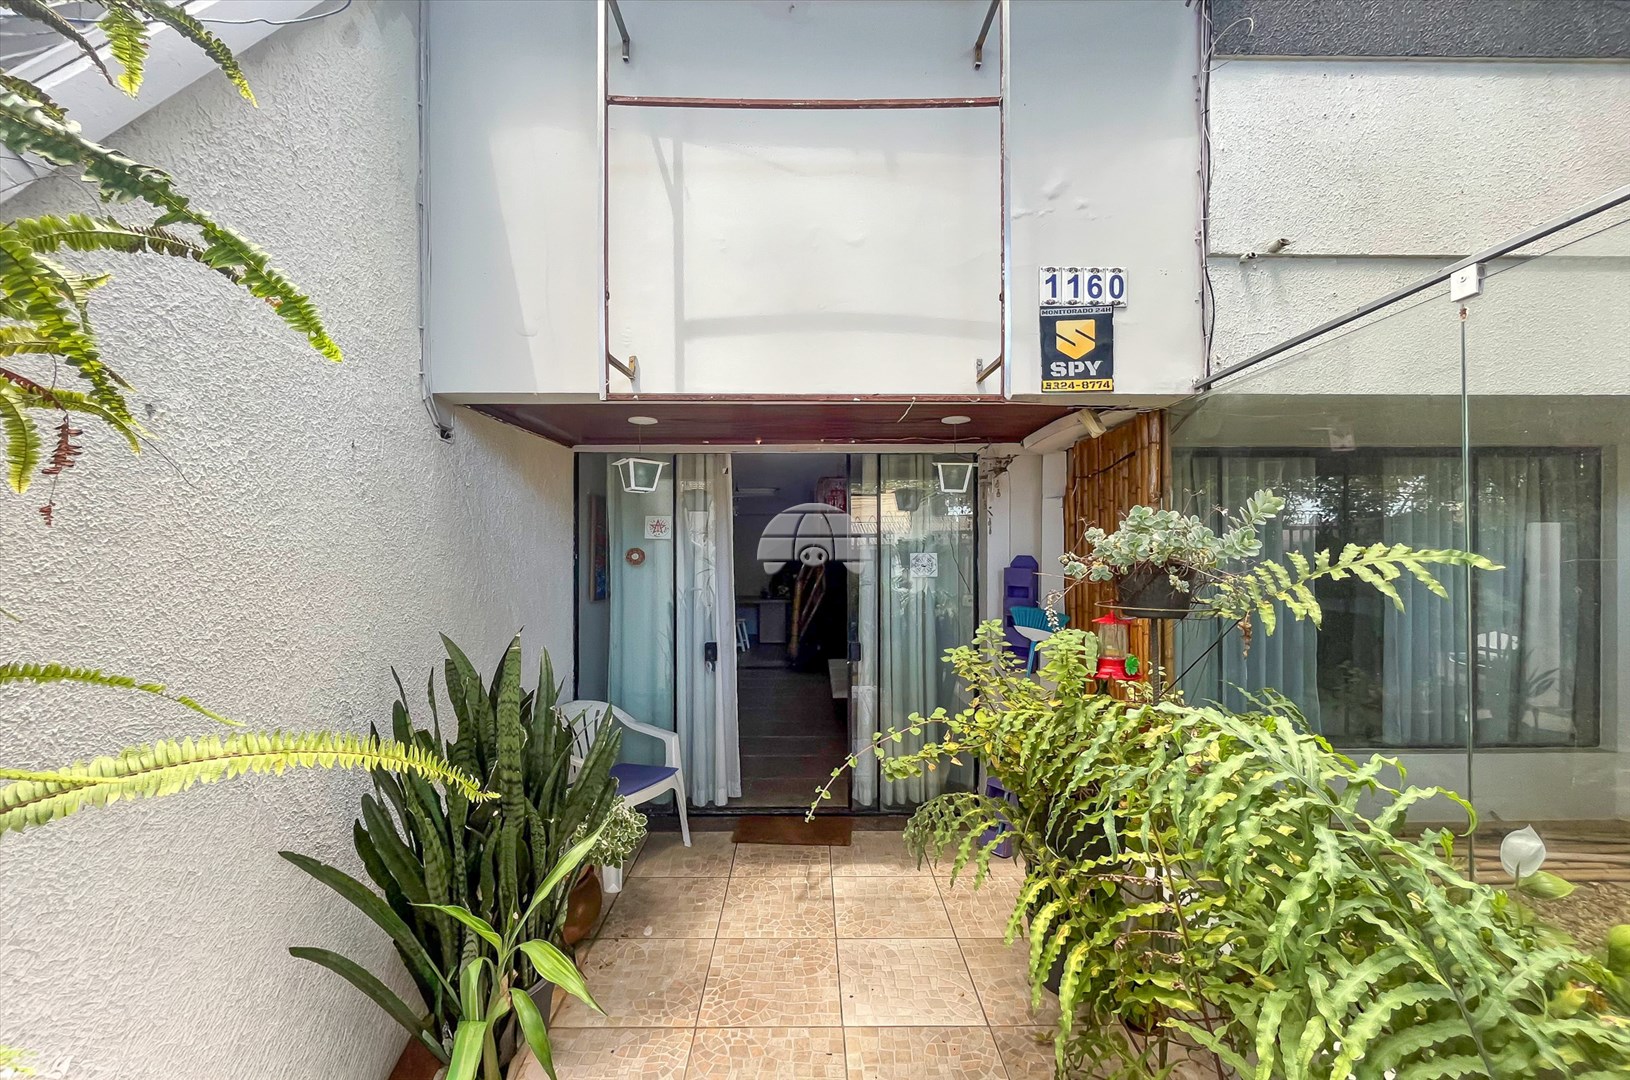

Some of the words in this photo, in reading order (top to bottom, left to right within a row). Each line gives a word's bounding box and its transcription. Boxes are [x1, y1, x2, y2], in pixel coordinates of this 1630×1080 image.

[1045, 273, 1125, 299] 1160
[1041, 308, 1094, 316] MONITORADO
[1050, 360, 1103, 377] SPY
